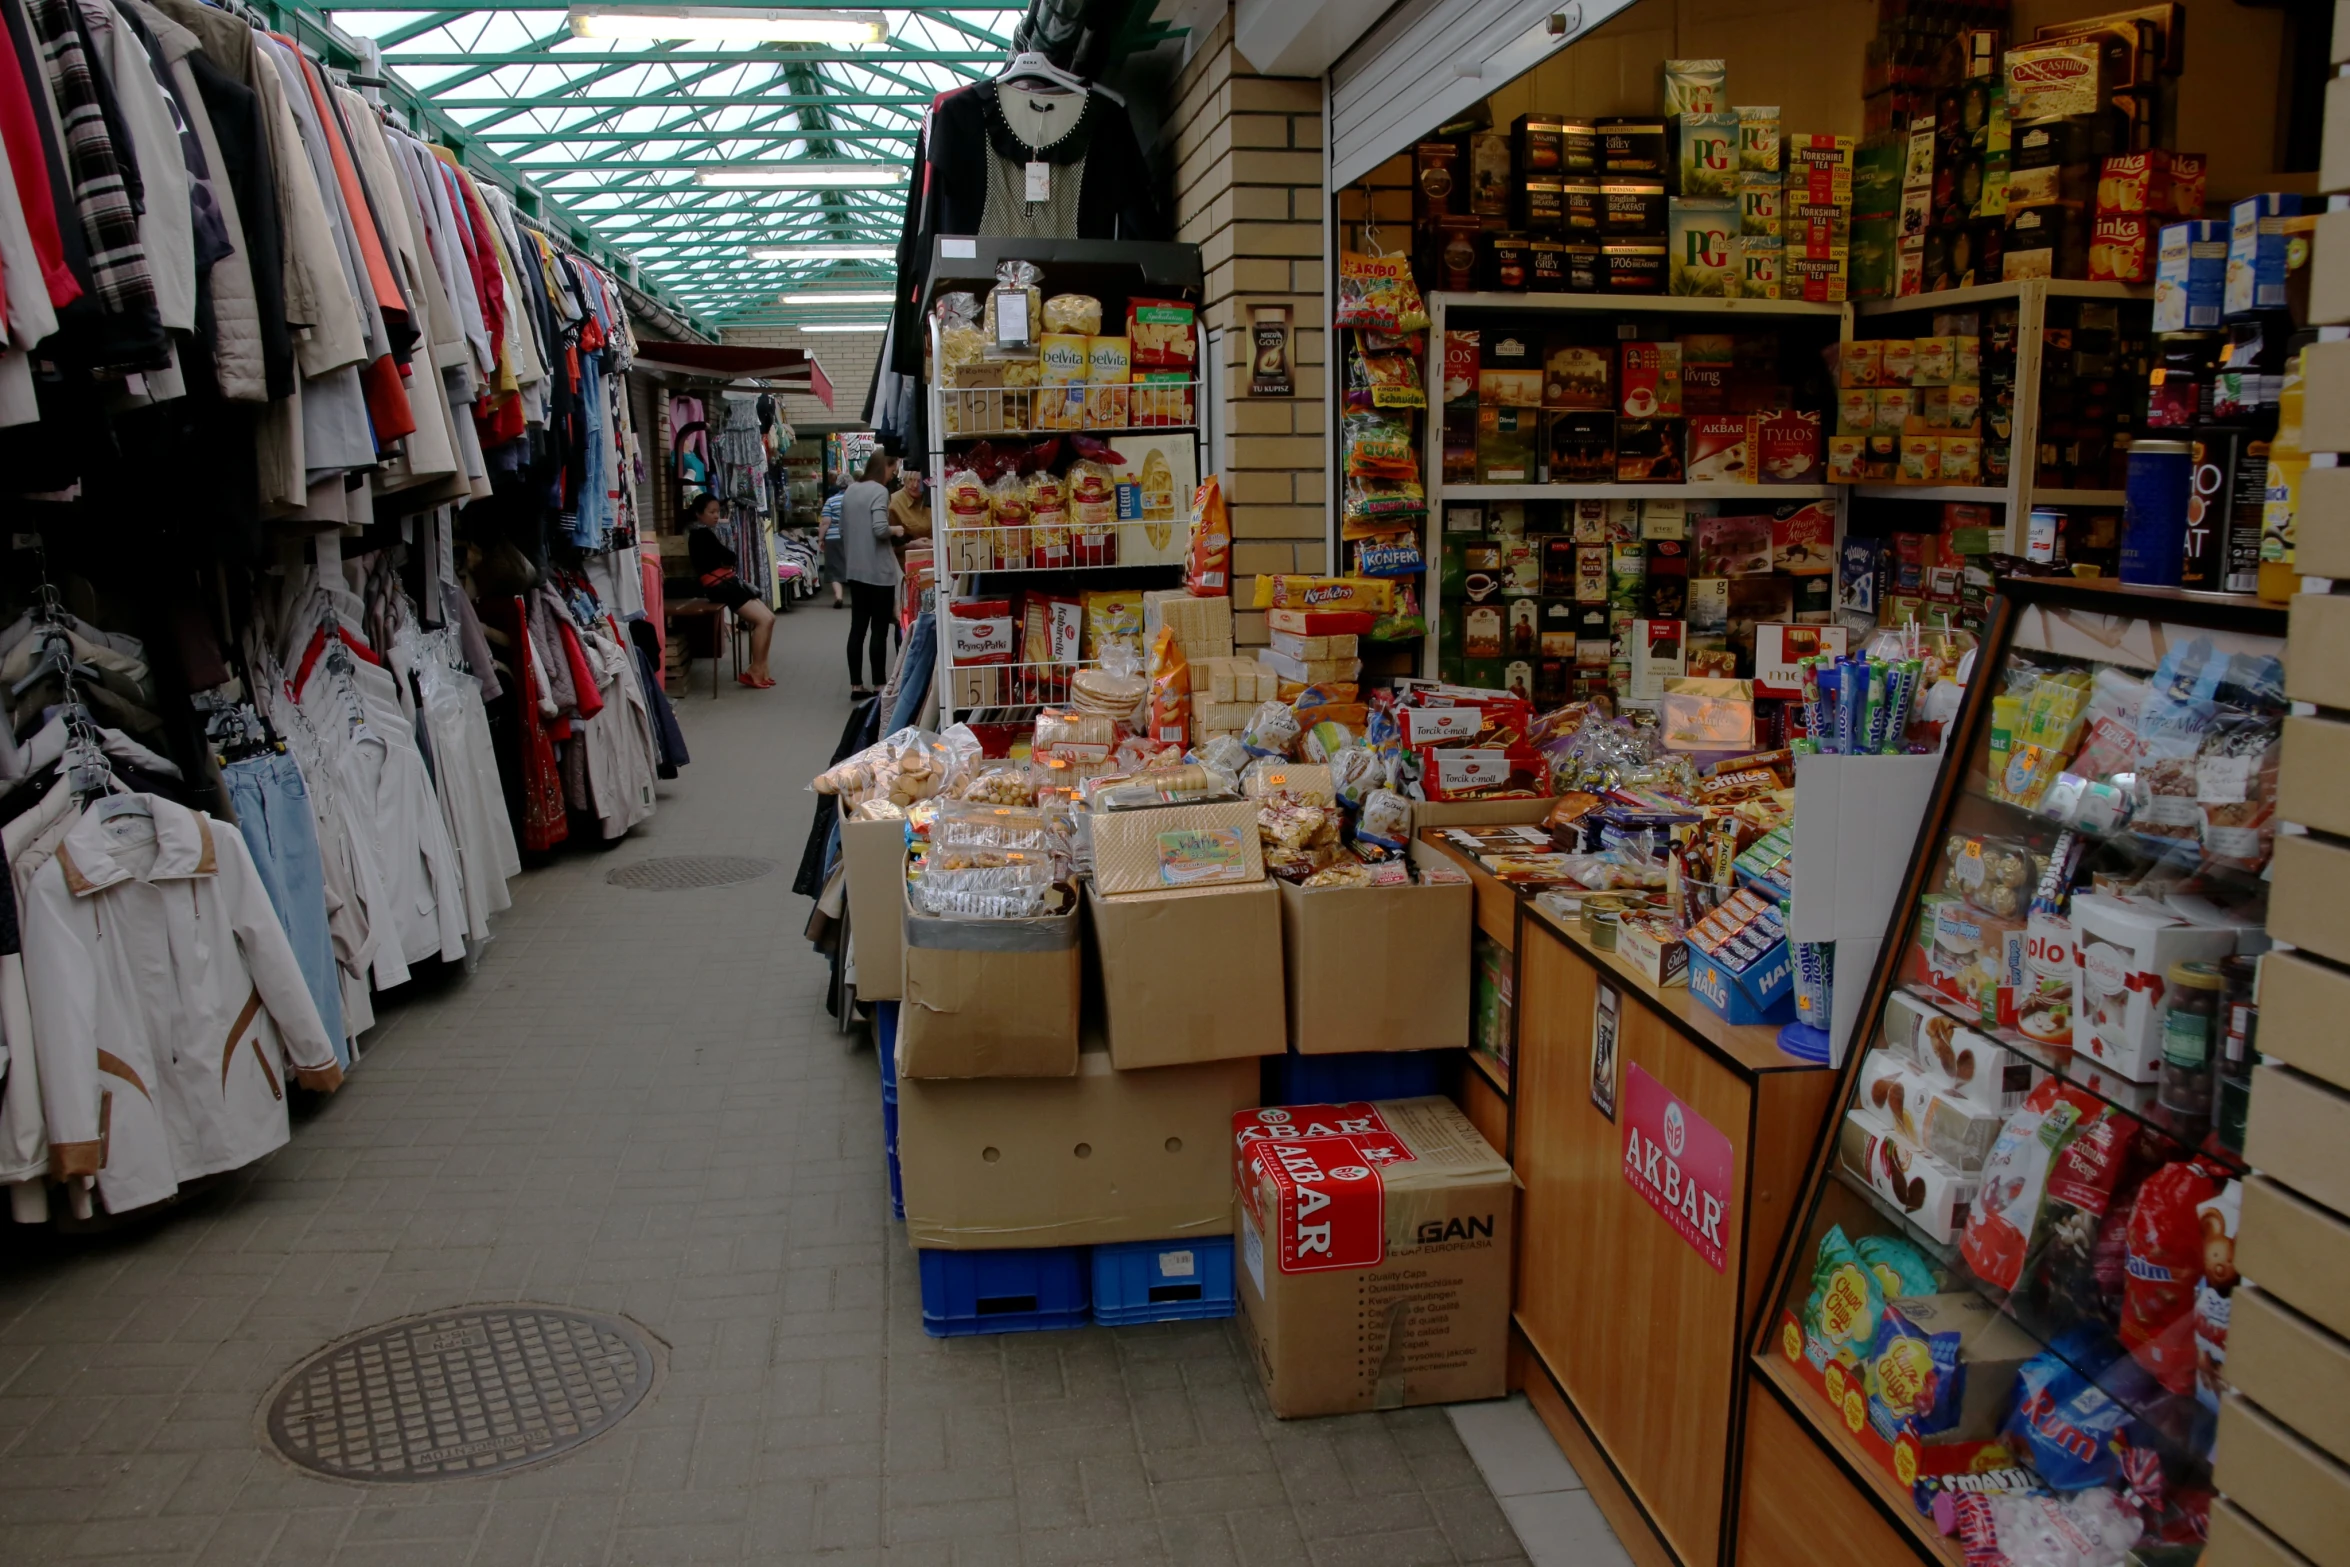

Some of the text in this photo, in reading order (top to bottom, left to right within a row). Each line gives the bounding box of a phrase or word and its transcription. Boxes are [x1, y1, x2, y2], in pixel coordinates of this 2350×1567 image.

[2016, 58, 2087, 78] LANCASHIRE
[1606, 140, 1631, 149] GREY
[1741, 128, 1769, 151] PG
[1693, 139, 1732, 170] PG tips
[1802, 151, 1843, 161] YORKSHIRE
[2106, 154, 2146, 171] inka
[1814, 161, 1829, 170] TEA
[1608, 202, 1646, 211] BREAKFAST
[1609, 195, 1637, 203] English
[1746, 193, 1773, 216] PG
[1800, 207, 1840, 217] YORKSHIRE
[1812, 217, 1826, 225] TEA
[2097, 218, 2140, 236] inka
[1685, 230, 1732, 267] PG tips
[1344, 260, 1397, 277] HARIBO
[1535, 260, 1559, 269] GREY
[1610, 257, 1632, 268] 1706
[1746, 258, 1773, 280] PG
[1798, 262, 1838, 271] YORKSHIRE
[1810, 272, 1825, 280] TEA
[1043, 348, 1083, 365] belVita
[1088, 349, 1127, 366] belVita
[1684, 366, 1720, 386] living
[1702, 424, 1743, 433] AKBAR
[1764, 428, 1813, 441] TYLOS
[1363, 443, 1411, 461] QUAXI
[1121, 486, 1130, 517] DE CECCO
[1304, 587, 1355, 603] Krakersy
[1891, 675, 1911, 741] mentos
[1418, 726, 1468, 735] Torcik c-moll
[2098, 722, 2131, 749] Dzika
[1446, 774, 1496, 783] Torcik c-moll
[1718, 837, 1730, 878] JACOBS
[2028, 937, 2064, 963] plo
[1691, 967, 1728, 1009] HALLS
[1236, 1118, 1380, 1142] KBAR
[1625, 1125, 1722, 1249] AKBAR
[1272, 1143, 1332, 1259] AKBAR
[1624, 1167, 1723, 1268] PREMIUM QUALITY TEA
[1424, 1240, 1493, 1254] EUROPE/ASIA
[1369, 1270, 1427, 1283] Quality Caps
[1369, 1278, 1463, 1294] Qualitätsverschlüsse
[1836, 1276, 1860, 1312] Chupa
[1414, 1302, 1460, 1313] de Qualité
[1826, 1294, 1854, 1333] Chups
[1419, 1315, 1449, 1325] qualità
[1418, 1326, 1450, 1336] calidad
[1408, 1352, 1444, 1361] wysokiej
[1892, 1345, 1921, 1388] Chupa
[1878, 1357, 1915, 1409] Chups
[2021, 1388, 2098, 1463] Rum
